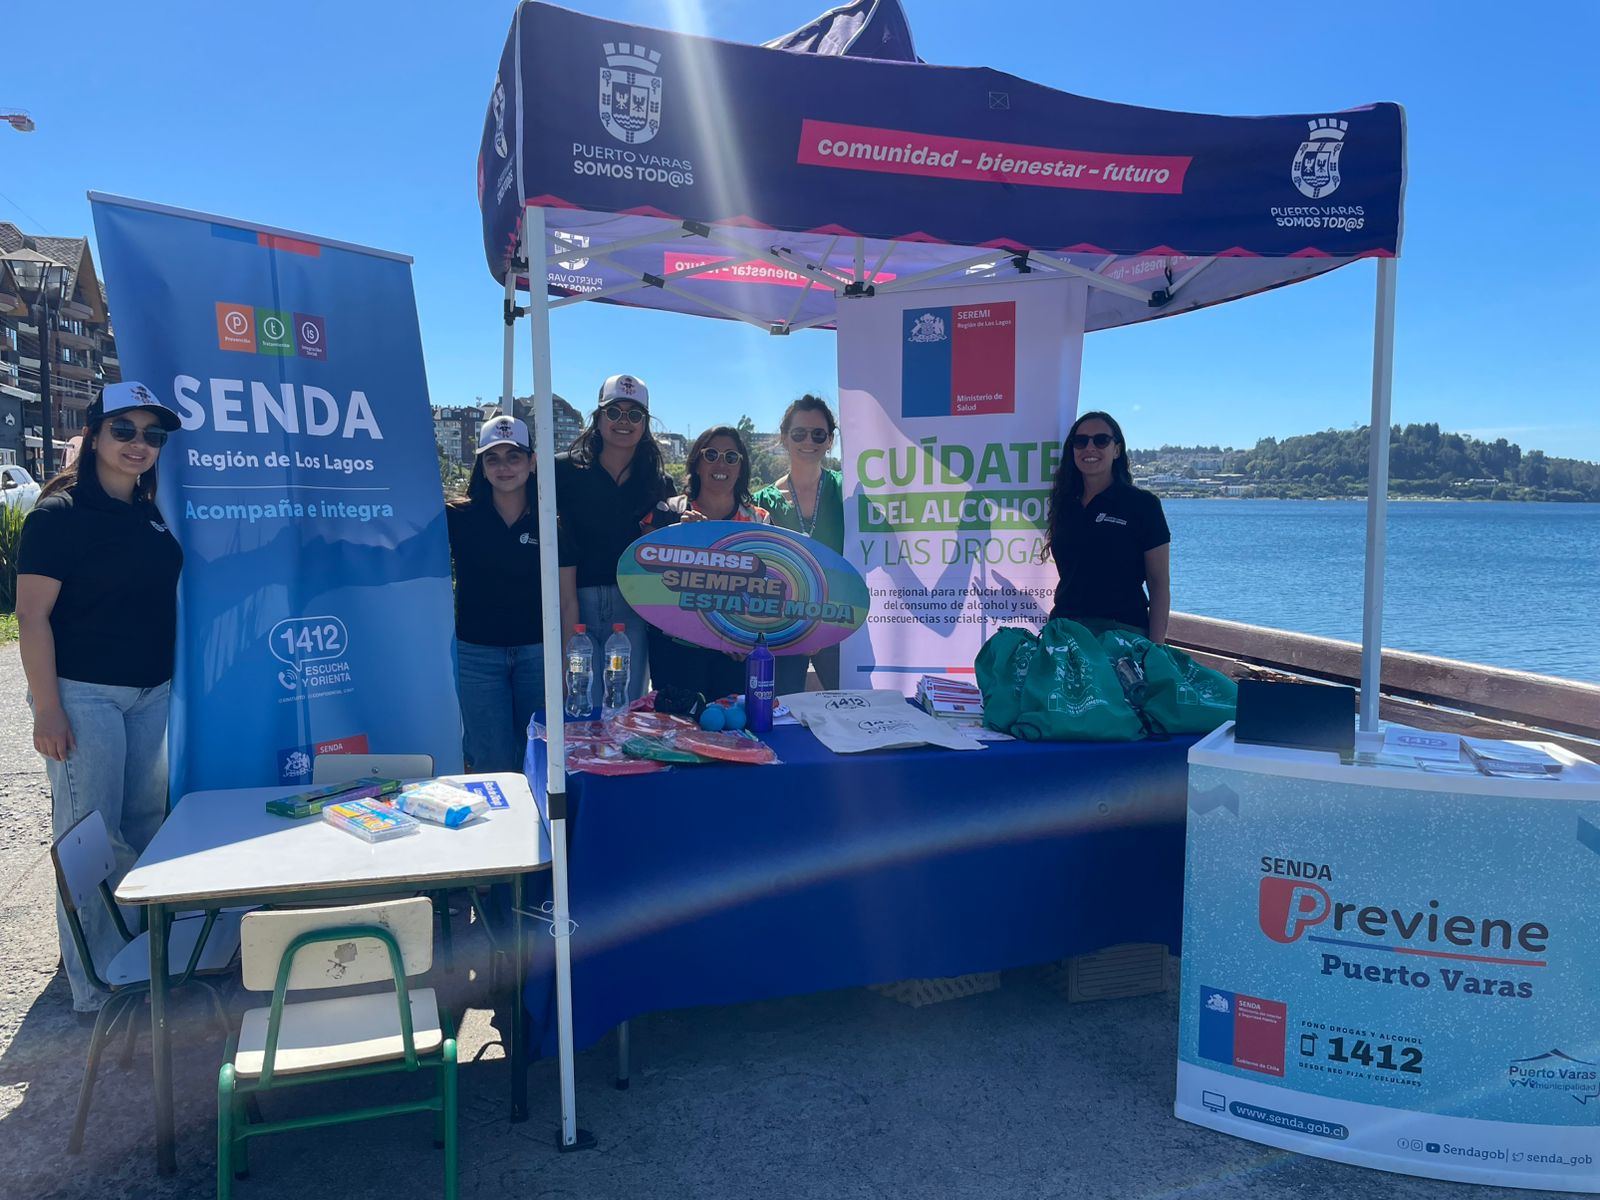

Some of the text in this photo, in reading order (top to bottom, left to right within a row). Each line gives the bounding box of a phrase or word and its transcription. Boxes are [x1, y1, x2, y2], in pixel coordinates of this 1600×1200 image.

[572, 143, 693, 171] PUERTO VARAS
[817, 136, 958, 168] comunidad
[976, 152, 1087, 179] bienestar
[1102, 163, 1170, 184] futuro
[573, 160, 695, 188] SOMOS TOD@S
[1270, 205, 1365, 217] PUERTO VARAS
[1276, 216, 1365, 232] SOMOS TOD@S
[957, 309, 991, 320] SEREMI
[173, 374, 384, 439] SENDA
[956, 392, 1003, 403] Ministerio de
[956, 403, 977, 412] Salud
[187, 448, 375, 475] Región de Los Lagos
[856, 436, 1062, 489] CUÍDATE
[185, 498, 394, 523] Acompaña e integra
[867, 500, 915, 525] DEL
[639, 546, 754, 570] CUIDARSE
[860, 540, 875, 565] Y
[884, 539, 931, 566] LAS
[662, 570, 783, 595] SIEMPRE
[889, 588, 928, 600] regional
[931, 589, 956, 600] para
[958, 586, 1000, 597] reducir
[1001, 587, 1017, 597] los
[679, 591, 855, 624] ESTA DE MODA
[883, 600, 1038, 612] del consumo de alcohol y sus
[867, 613, 1049, 626] consecuencias sociales y sanitaria
[280, 624, 341, 655] 1412
[301, 672, 352, 687] Y ORIENTA
[305, 661, 350, 676] ESCUCHA
[319, 743, 344, 754] SENDA
[1259, 856, 1333, 882] SENDA
[1259, 876, 1550, 952] Previene
[1321, 953, 1534, 999] Puerto Varas
[1238, 1000, 1261, 1010] SENDA
[1301, 1020, 1326, 1030] FONO
[1329, 1026, 1367, 1036] DROGAS
[1380, 1033, 1423, 1045] ALCOHOL
[1327, 1036, 1423, 1074] 1412
[1299, 1062, 1324, 1072] DESDE
[1346, 1070, 1364, 1078] FIJA
[1374, 1075, 1423, 1087] CELULARES
[1508, 1065, 1597, 1080] Puerto Varas
[1535, 1081, 1596, 1092] municipalidad
[1236, 1105, 1345, 1137] www.senda.gob.cl
[1526, 1153, 1593, 1167] senda_gob
